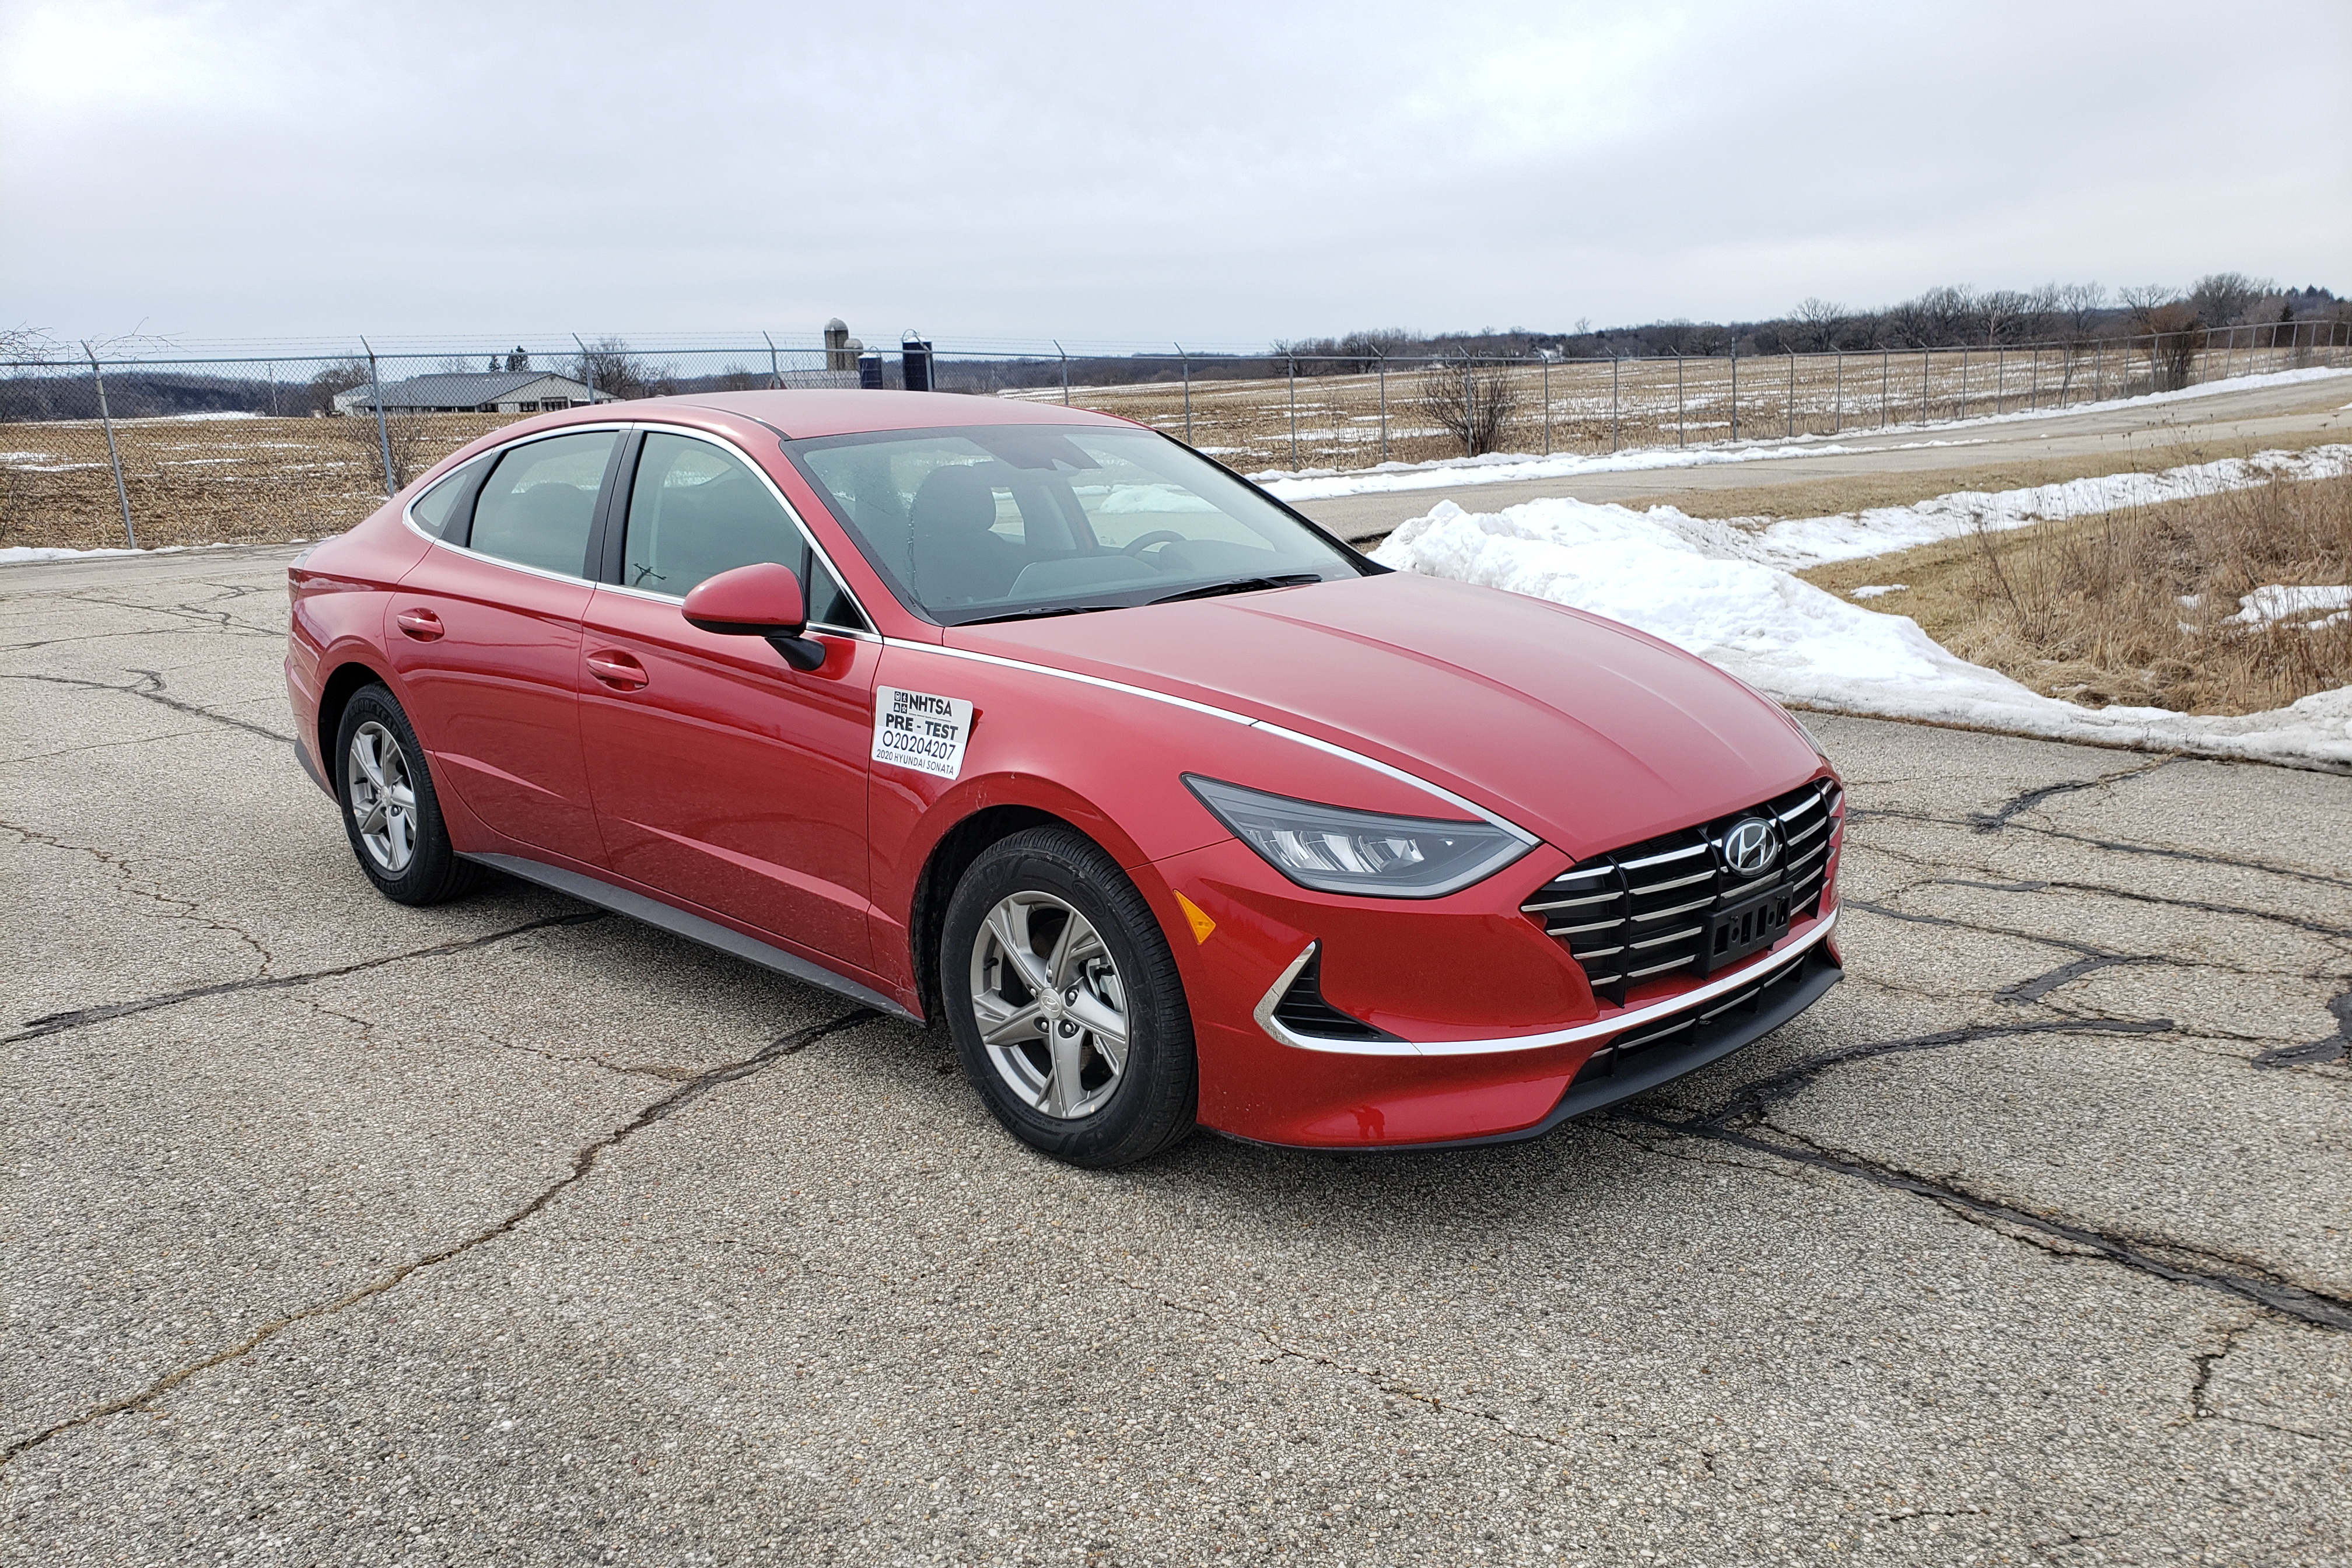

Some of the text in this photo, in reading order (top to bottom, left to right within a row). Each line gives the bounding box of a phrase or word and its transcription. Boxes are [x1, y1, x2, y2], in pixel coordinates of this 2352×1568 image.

[909, 694, 952, 716] NHTSA
[886, 713, 914, 732] PRE
[925, 721, 958, 740] TEST
[876, 749, 954, 775] 2020 HYUNDAI SONATA
